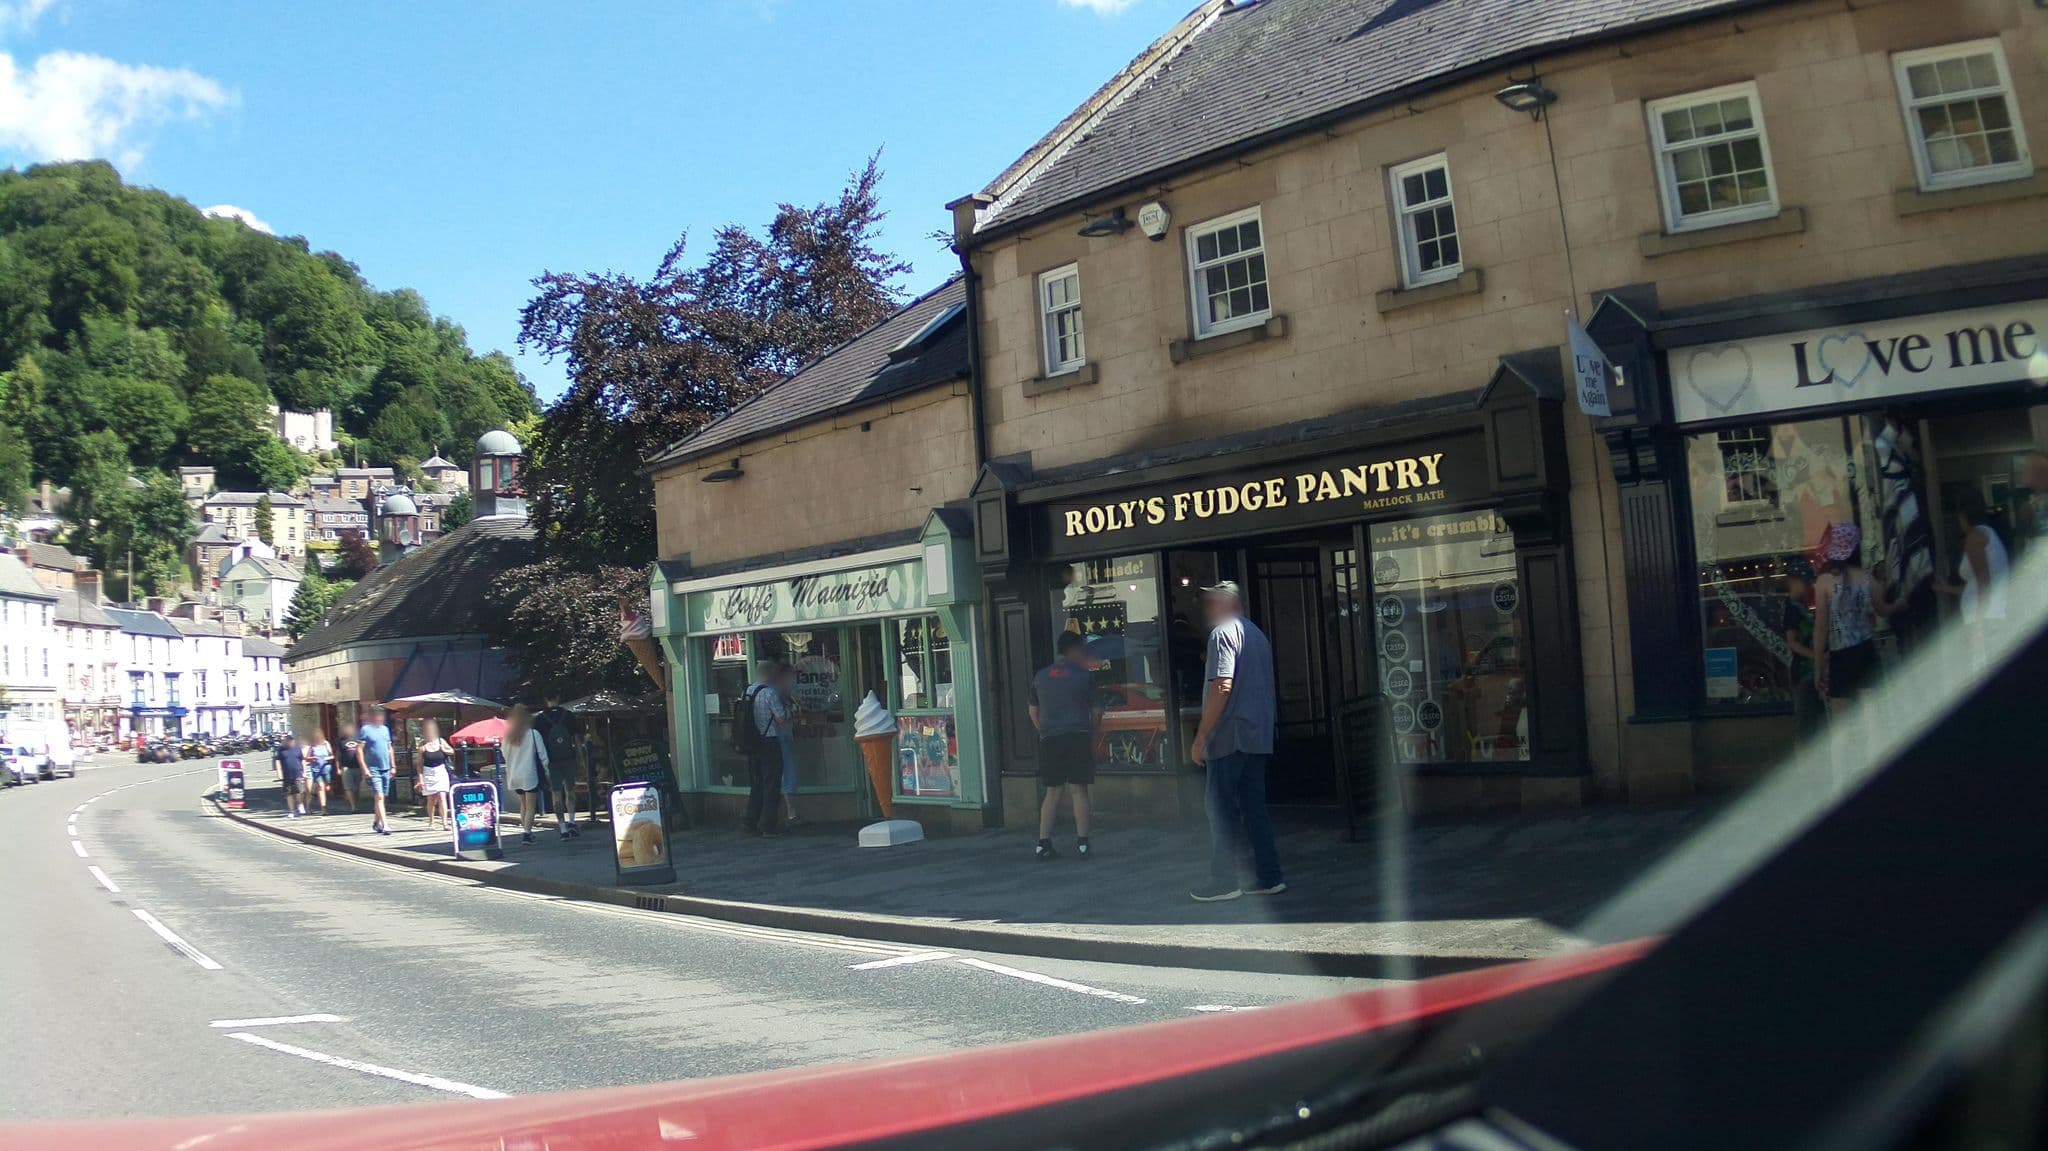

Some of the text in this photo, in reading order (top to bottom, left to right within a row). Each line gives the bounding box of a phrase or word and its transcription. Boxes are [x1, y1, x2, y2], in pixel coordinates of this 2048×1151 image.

[1945, 319, 2037, 369] me
[1582, 389, 1606, 407] Again
[1065, 453, 1443, 536] ROLY'S FUDGE PANTRY
[1363, 489, 1446, 510] MATLOCK BATH
[791, 574, 889, 611] Maurizio
